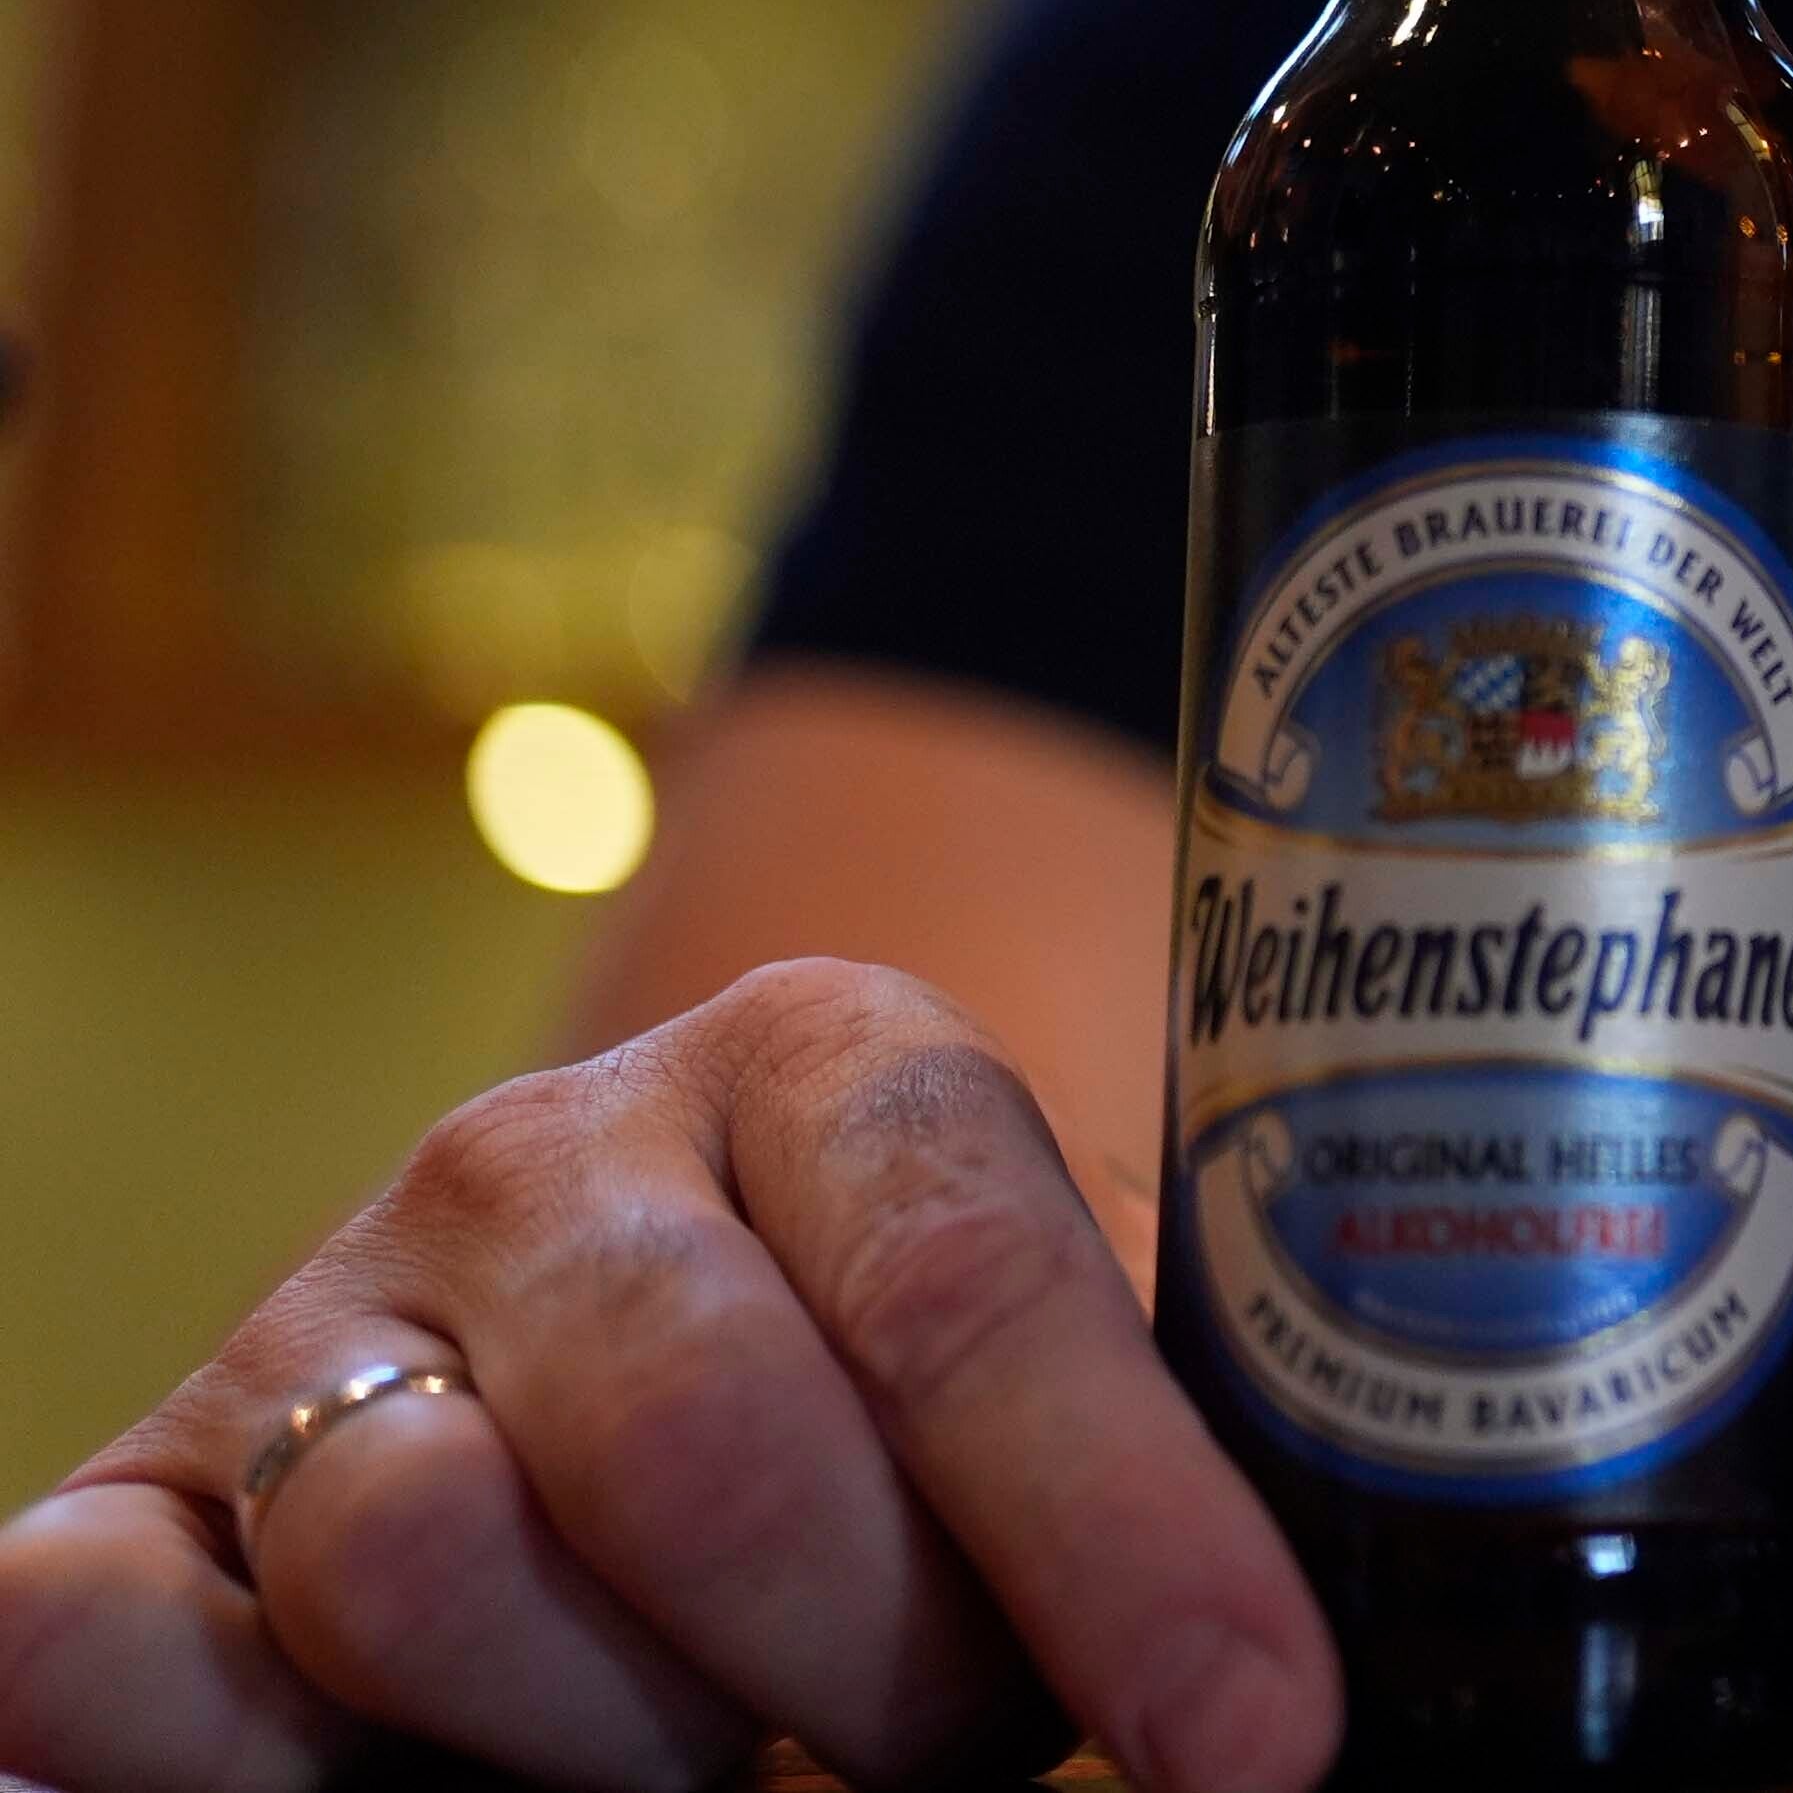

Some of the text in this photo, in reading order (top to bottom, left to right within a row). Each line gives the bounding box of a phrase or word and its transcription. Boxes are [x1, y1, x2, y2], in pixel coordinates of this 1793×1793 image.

[1395, 496, 1628, 560] BRAUEREI
[1648, 531, 1725, 606] DER
[1249, 1293, 1444, 1427] PREMIUM
[1468, 1289, 1749, 1433] BAVARICUM
